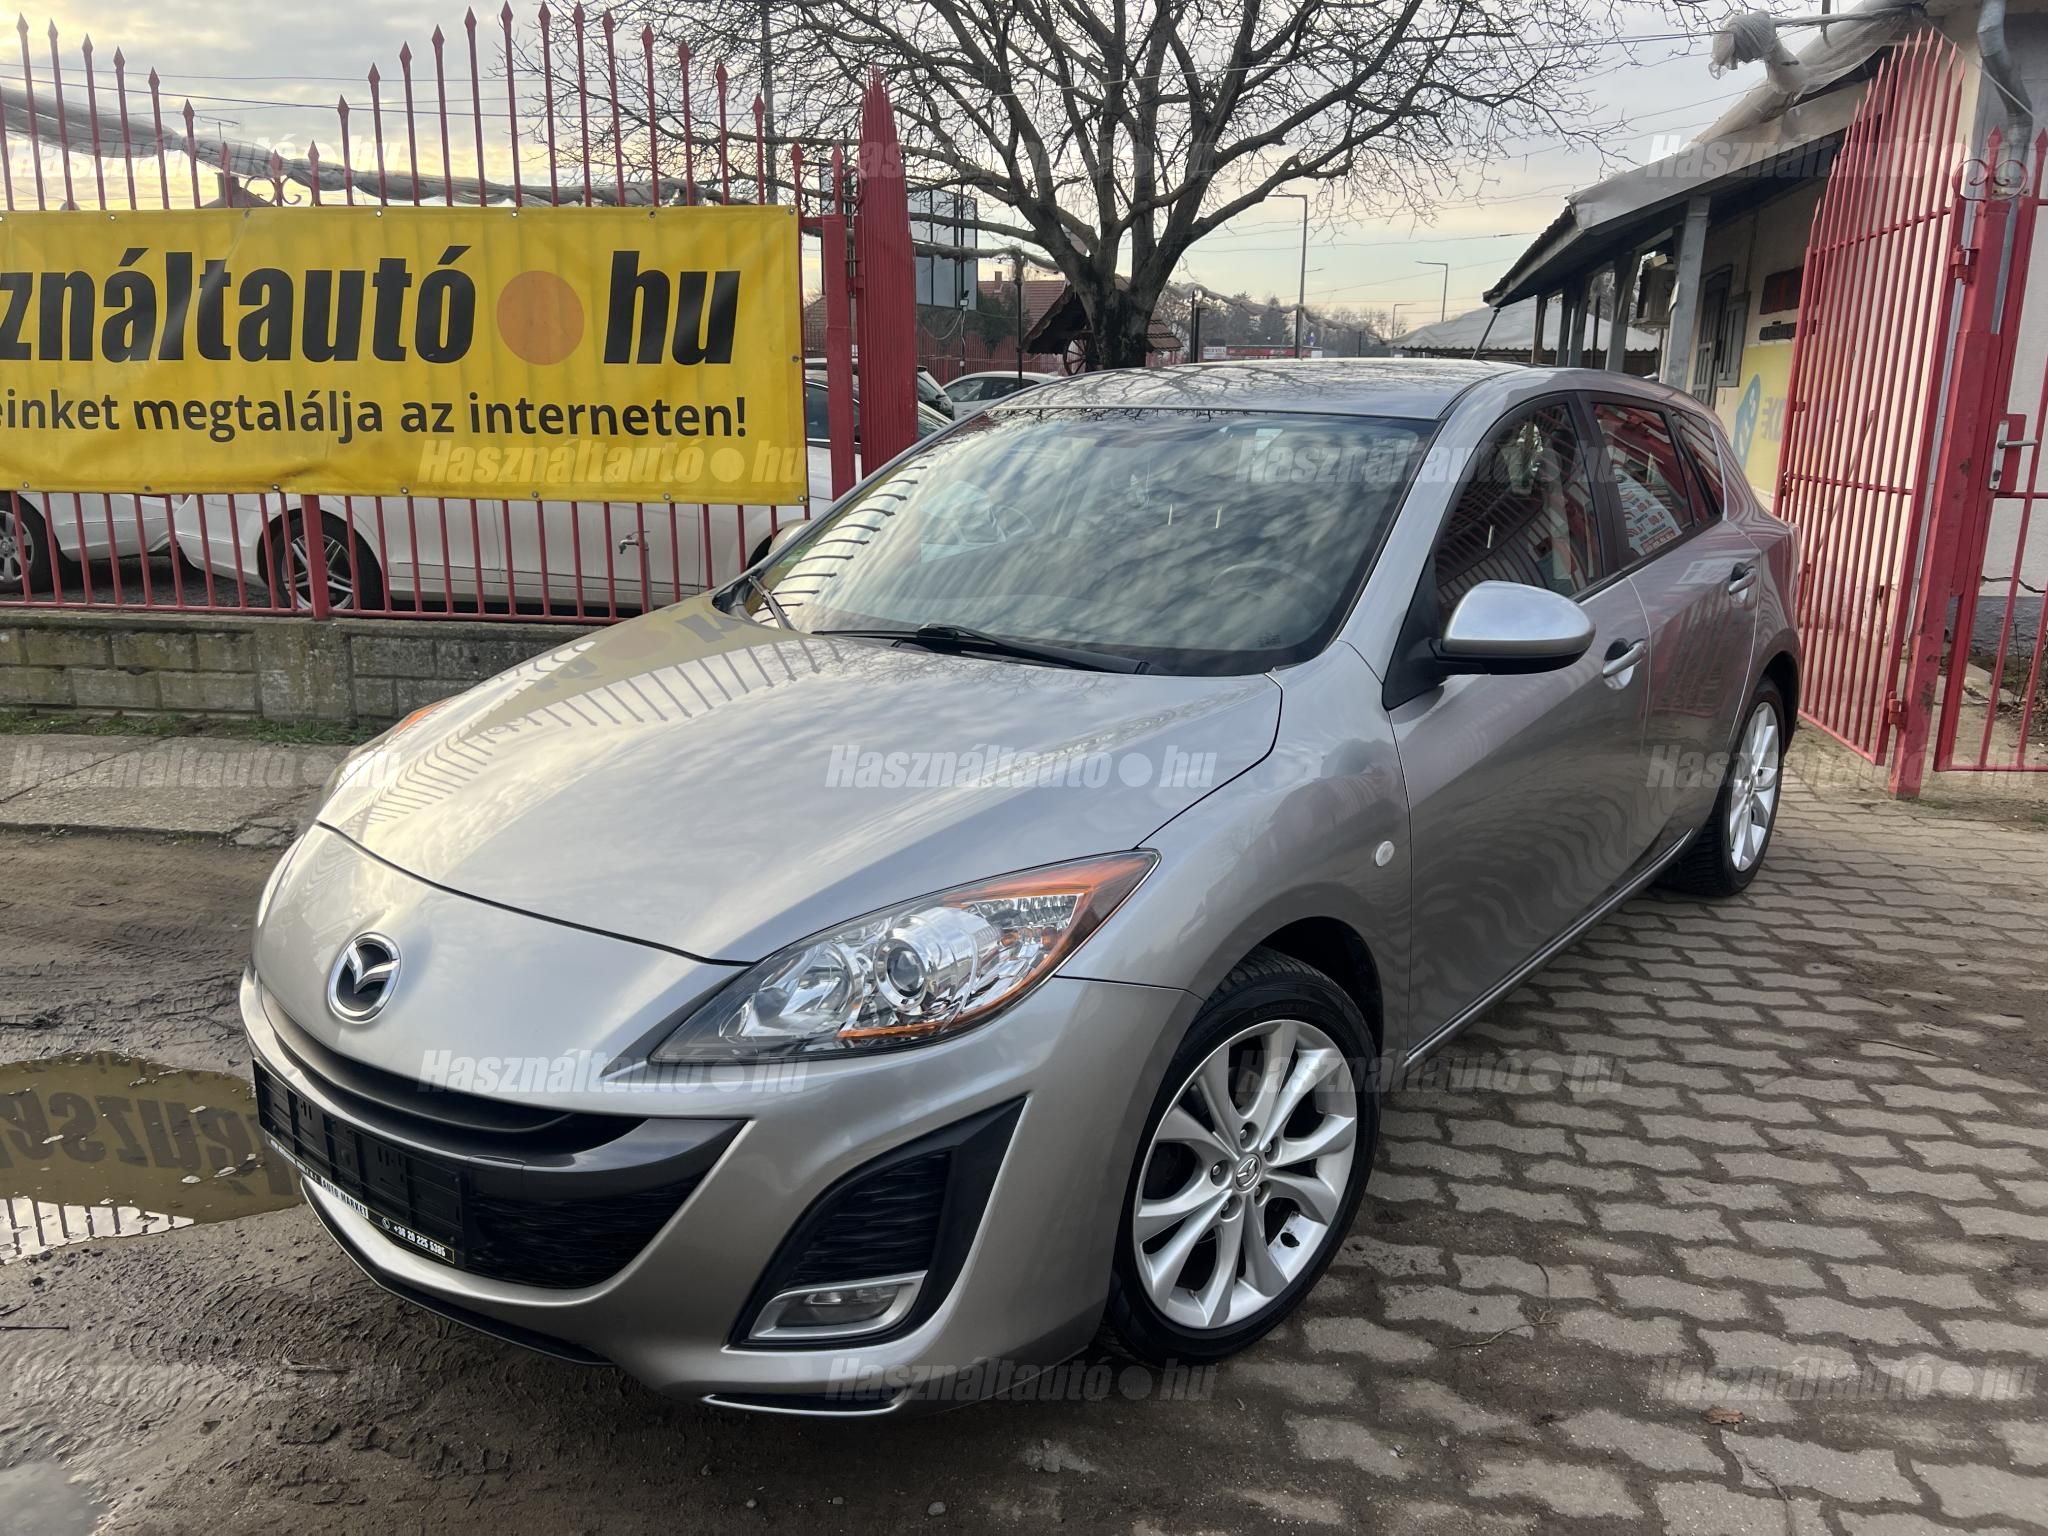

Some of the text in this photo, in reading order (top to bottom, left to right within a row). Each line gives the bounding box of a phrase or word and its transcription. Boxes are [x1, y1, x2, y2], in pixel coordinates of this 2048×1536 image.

[603, 250, 741, 365] hu
[0, 389, 747, 443] inket megtalálja az interneten!
[341, 1191, 368, 1218] MARKET
